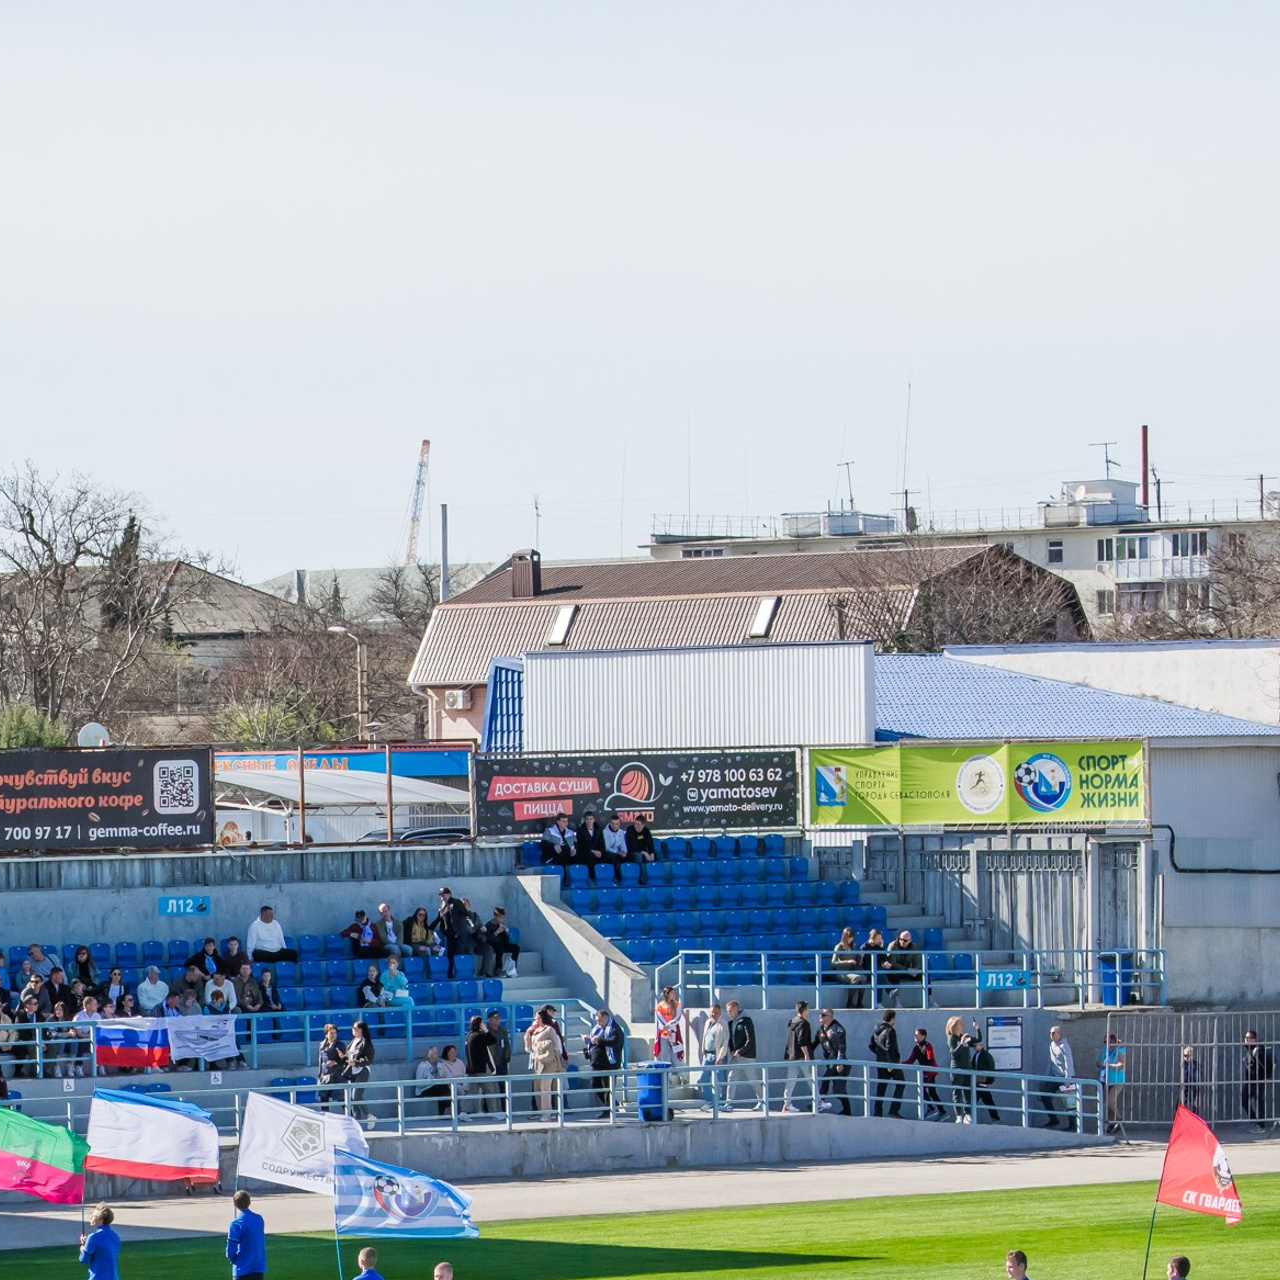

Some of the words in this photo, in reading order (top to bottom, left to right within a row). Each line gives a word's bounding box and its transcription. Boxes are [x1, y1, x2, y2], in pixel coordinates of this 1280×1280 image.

[1078, 754, 1128, 771] СПОРТ
[91, 767, 132, 789] вкус
[681, 769, 695, 783] +7
[697, 769, 722, 783] 978
[724, 769, 746, 782] 100
[748, 768, 764, 782] 63
[767, 767, 783, 781] 62
[854, 770, 899, 779] УПРАВЛЕНИЕ
[1079, 773, 1139, 790] НОРМА
[494, 781, 558, 797] ДОСТАВКА
[559, 779, 594, 793] СУШИ
[854, 781, 886, 790] СПОРТА
[700, 785, 778, 803] yamatosev
[854, 790, 887, 800] ГОРОДА
[890, 790, 951, 800] СЕВАСТОПОЛЯ
[1080, 791, 1140, 809] ЖИЗНИ
[98, 794, 144, 811] кофе
[523, 802, 565, 817] ПИЦЦА
[682, 802, 783, 814] www.yamato-delivery.ru
[4, 826, 32, 840] 700
[35, 826, 51, 840] 97
[55, 825, 72, 839] 17
[88, 822, 201, 841] gemma-coffee.ru
[167, 899, 194, 913] Л12
[986, 973, 1014, 987] Л12
[261, 1161, 335, 1185] СОДРУЖЕСТВ
[1182, 1190, 1198, 1205] СК
